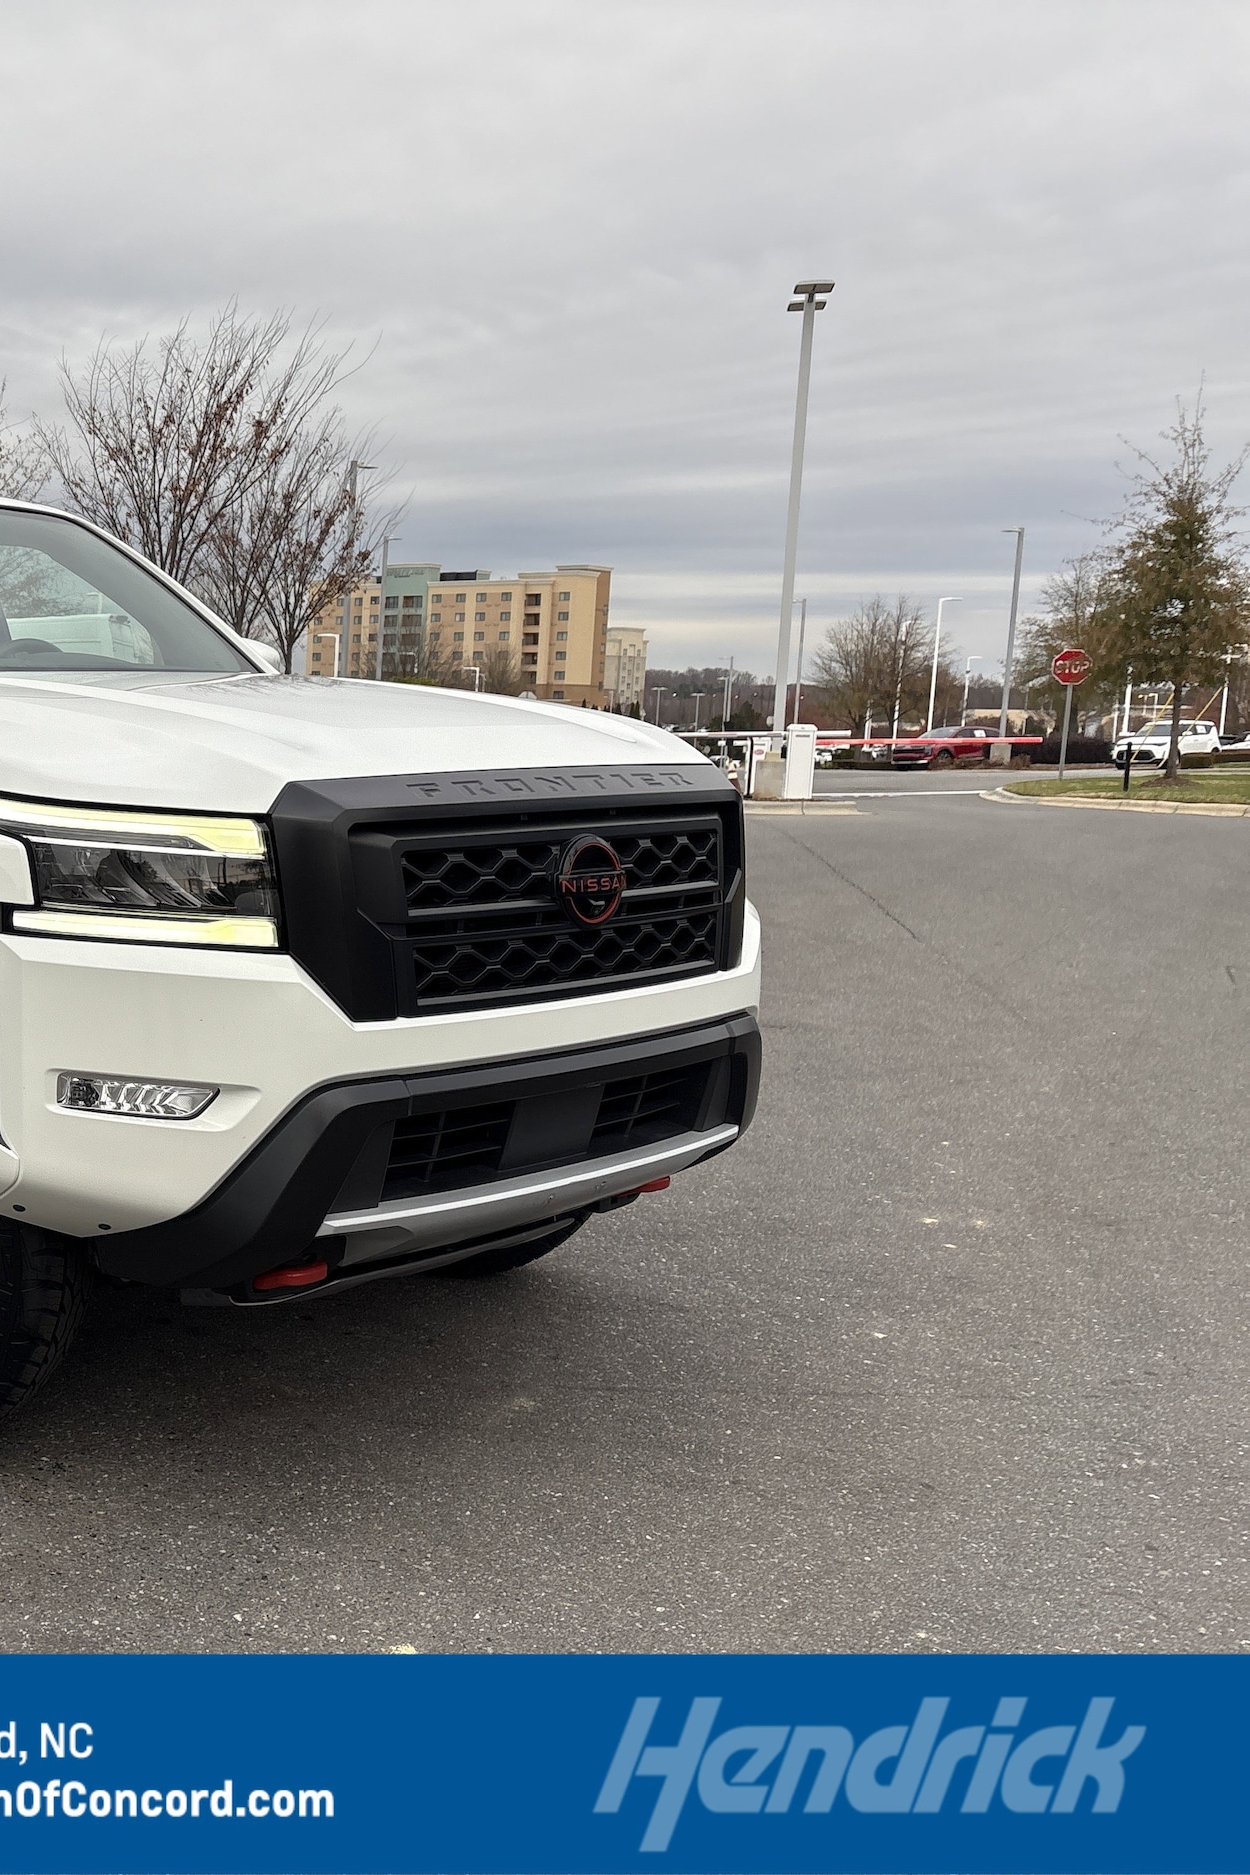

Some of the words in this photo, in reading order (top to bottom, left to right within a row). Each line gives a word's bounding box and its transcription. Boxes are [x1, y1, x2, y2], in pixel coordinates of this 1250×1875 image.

[1055, 660, 1090, 674] STOP
[406, 772, 694, 798] FRONTIER
[561, 874, 627, 893] NISSAN
